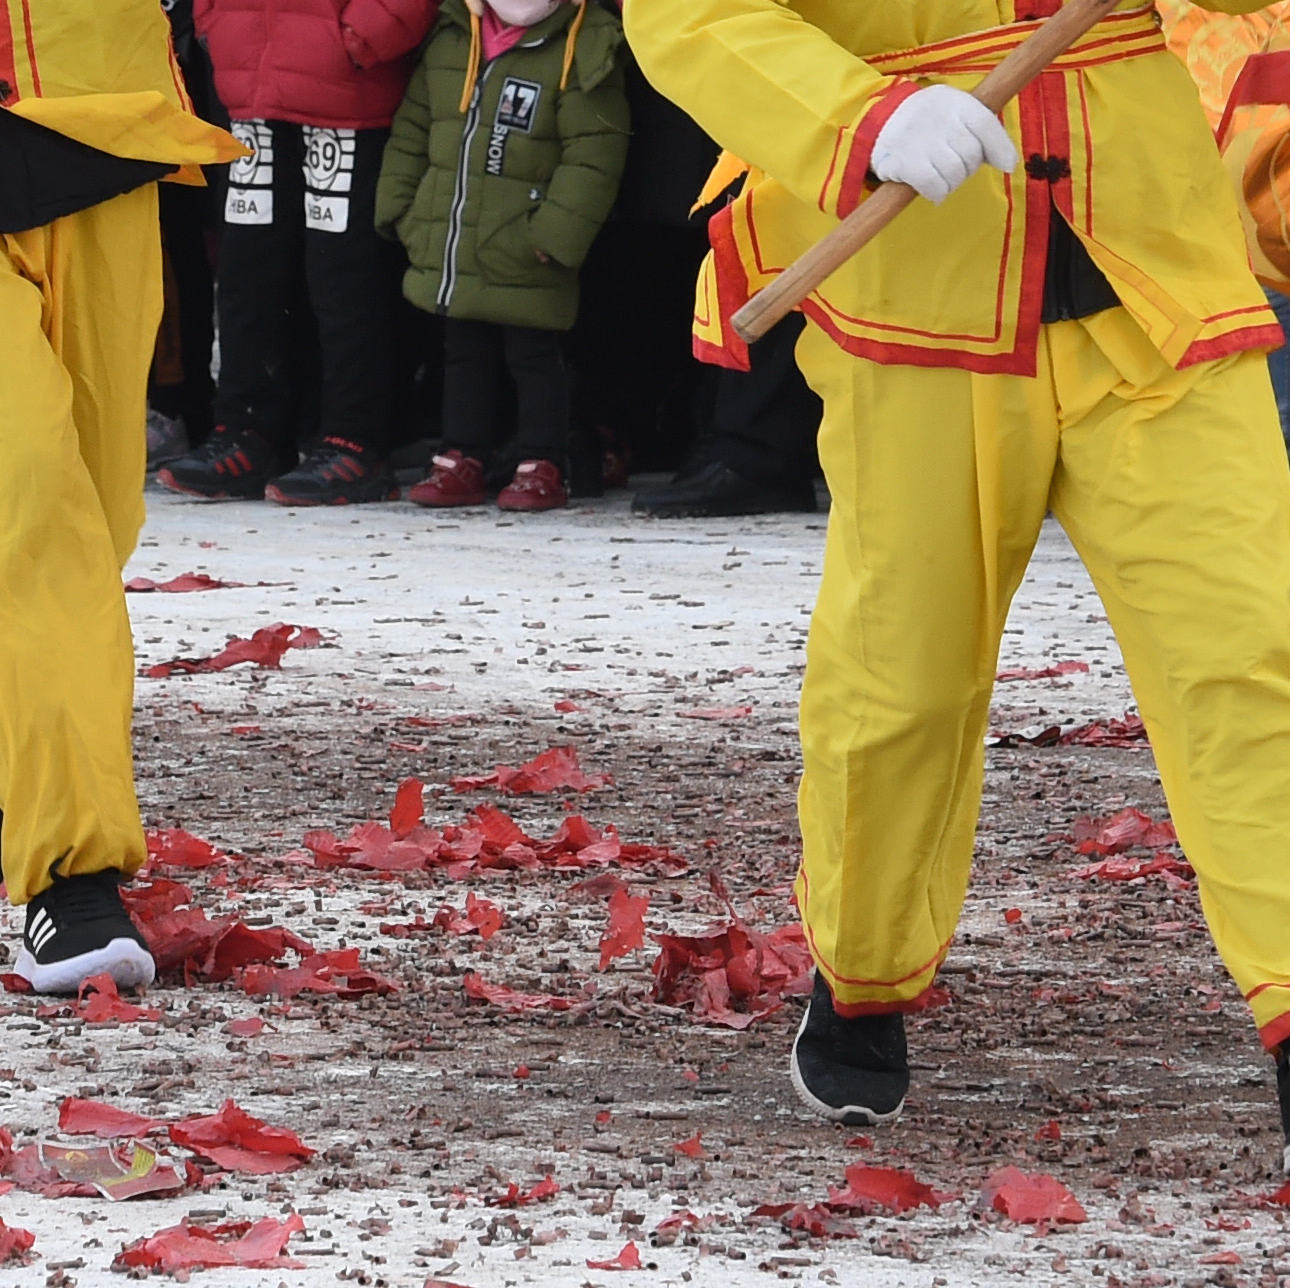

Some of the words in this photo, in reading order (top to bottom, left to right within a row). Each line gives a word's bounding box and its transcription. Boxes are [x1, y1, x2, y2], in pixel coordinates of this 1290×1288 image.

[500, 84, 536, 118] 17
[310, 140, 336, 172] 69
[486, 124, 509, 175] SNOW
